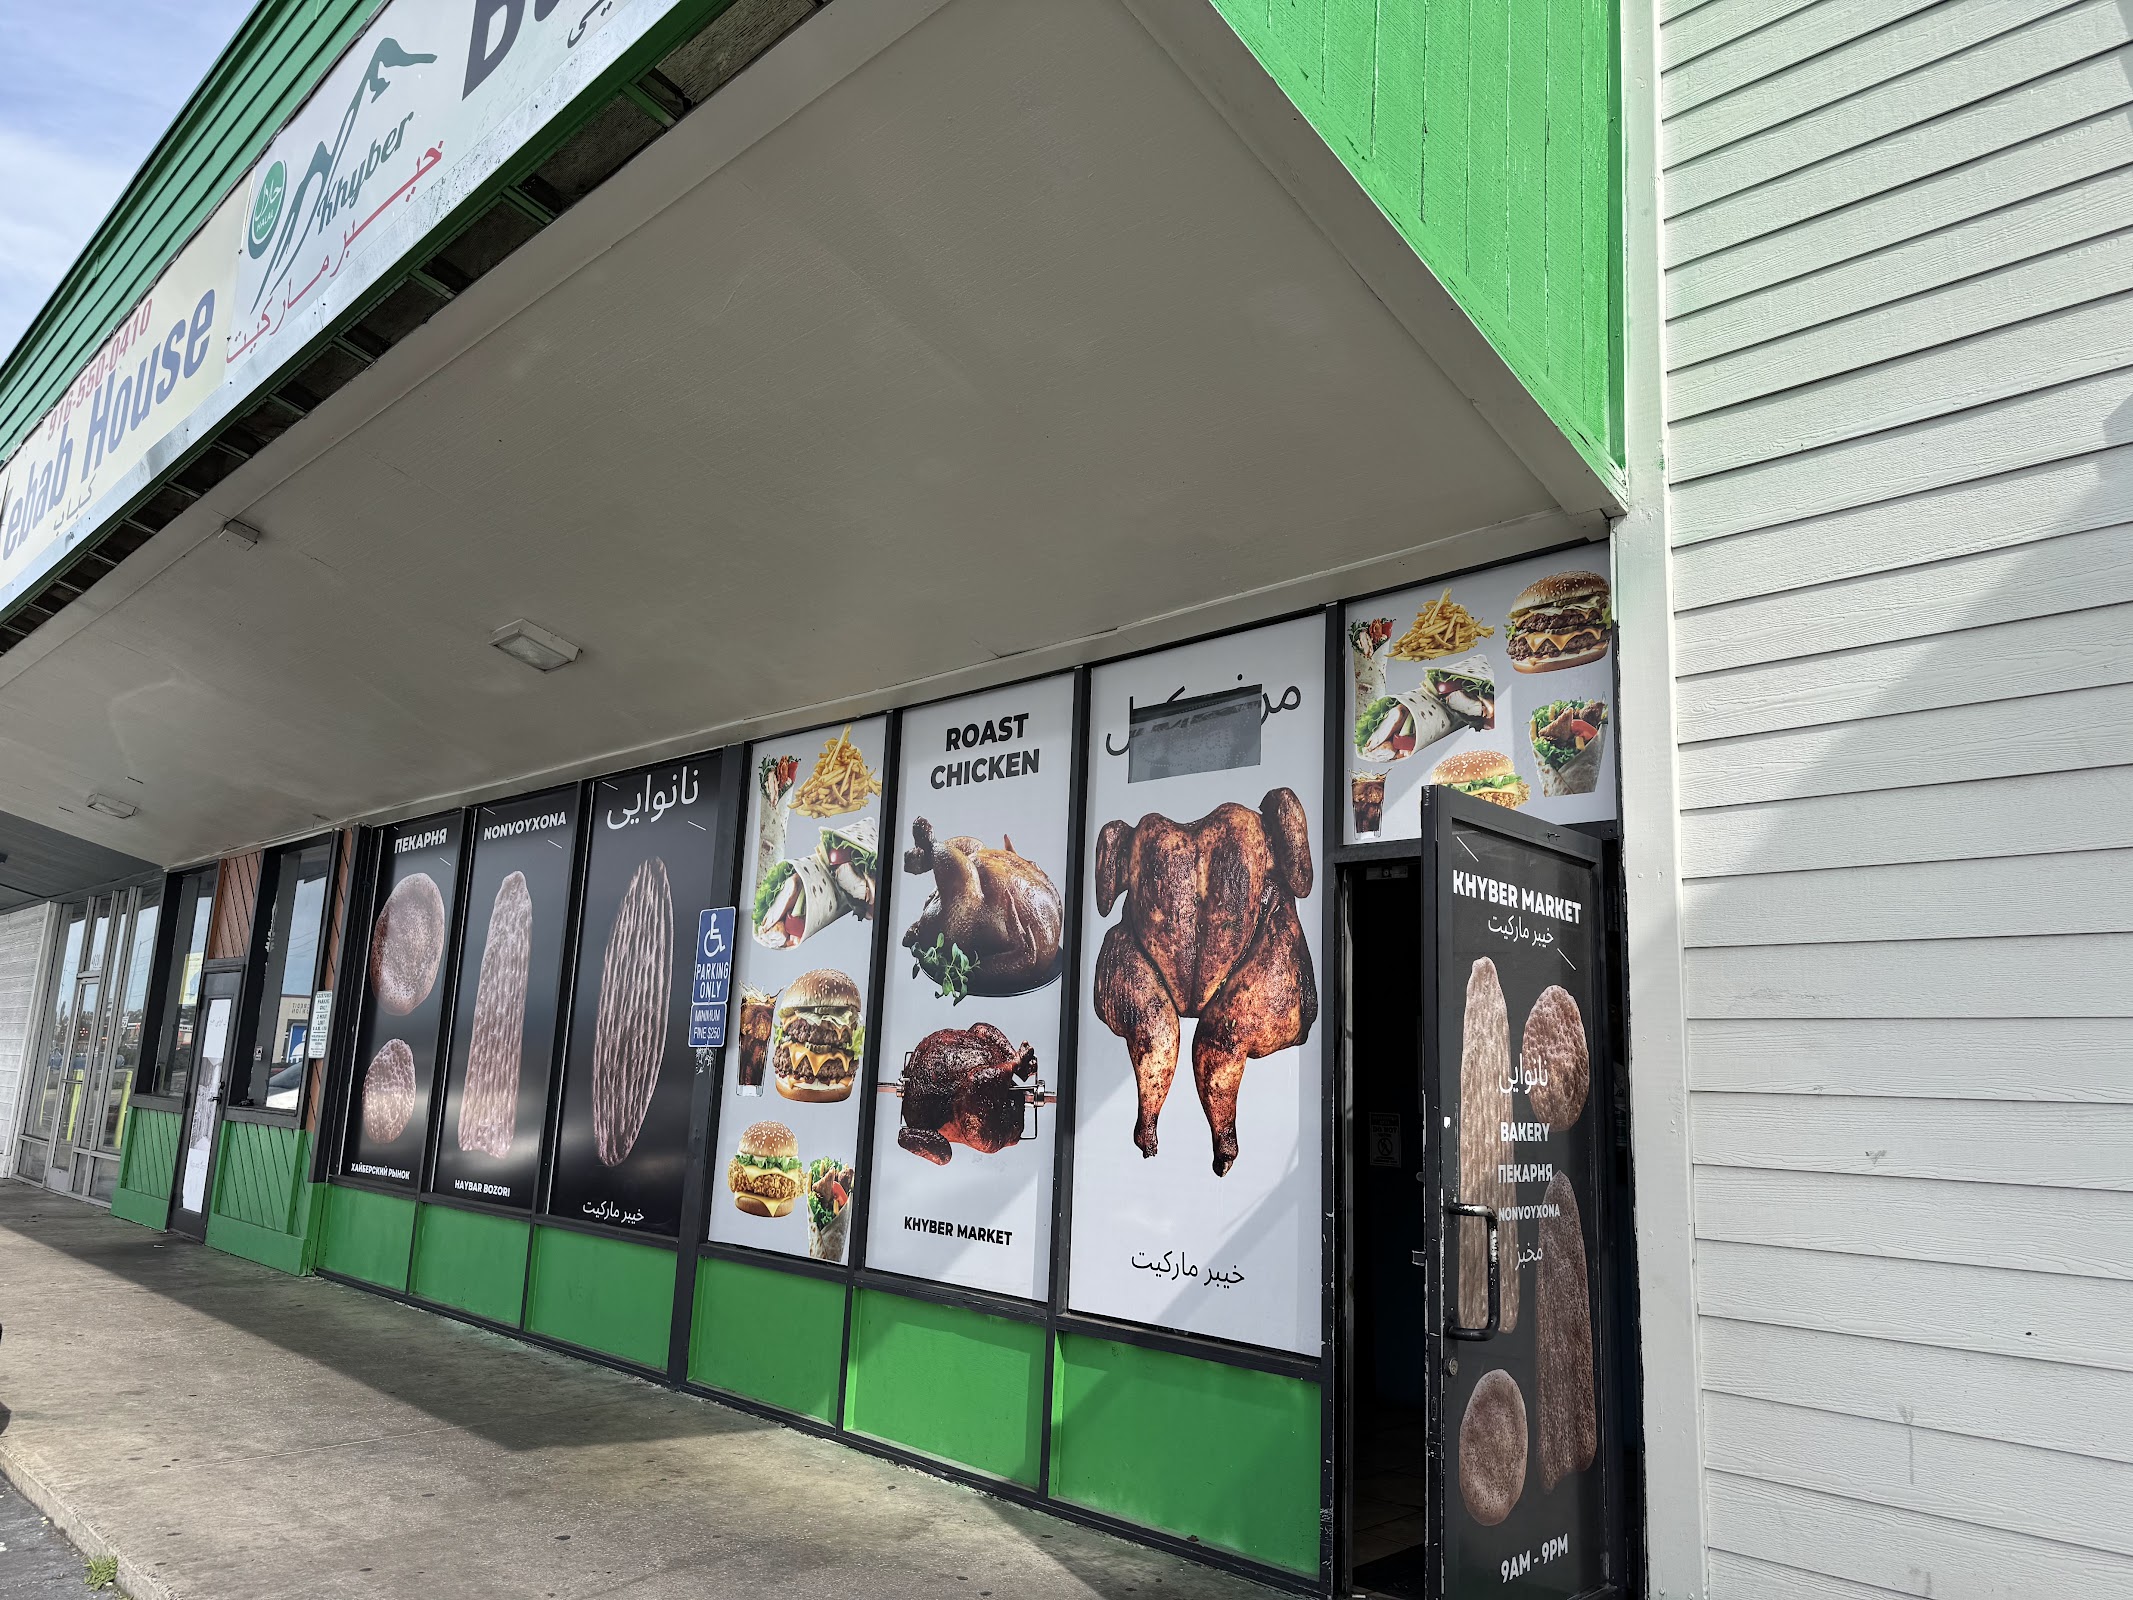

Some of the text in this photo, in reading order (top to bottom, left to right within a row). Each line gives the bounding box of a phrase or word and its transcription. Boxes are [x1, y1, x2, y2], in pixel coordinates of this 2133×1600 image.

[47, 298, 153, 442] 916-550-0410
[81, 288, 216, 484] House
[945, 712, 1030, 752] ROAST
[930, 748, 1040, 790] CHICKEN
[483, 811, 567, 841] NONVOYXONA
[394, 827, 448, 855] ПЕКАРНЯ
[1452, 869, 1582, 924] KHYBER MARKET
[696, 961, 730, 981] PARKING
[700, 981, 722, 999] ONLY
[694, 1009, 721, 1022] MINIMUM
[693, 1026, 721, 1039] FINE $250
[1500, 1121, 1551, 1142] BAKERY
[351, 1162, 410, 1180] ХАЙБЕРСКИЙ РЫНОК
[1498, 1163, 1553, 1184] ПЕКАРНЯ
[454, 1179, 511, 1197] HAYBAR BOZORI
[1498, 1203, 1561, 1222] NONVOYXONA
[904, 1216, 1013, 1246] KHYBER MARKET
[1500, 1549, 1531, 1584] 9AM
[1541, 1533, 1569, 1565] 9PM
